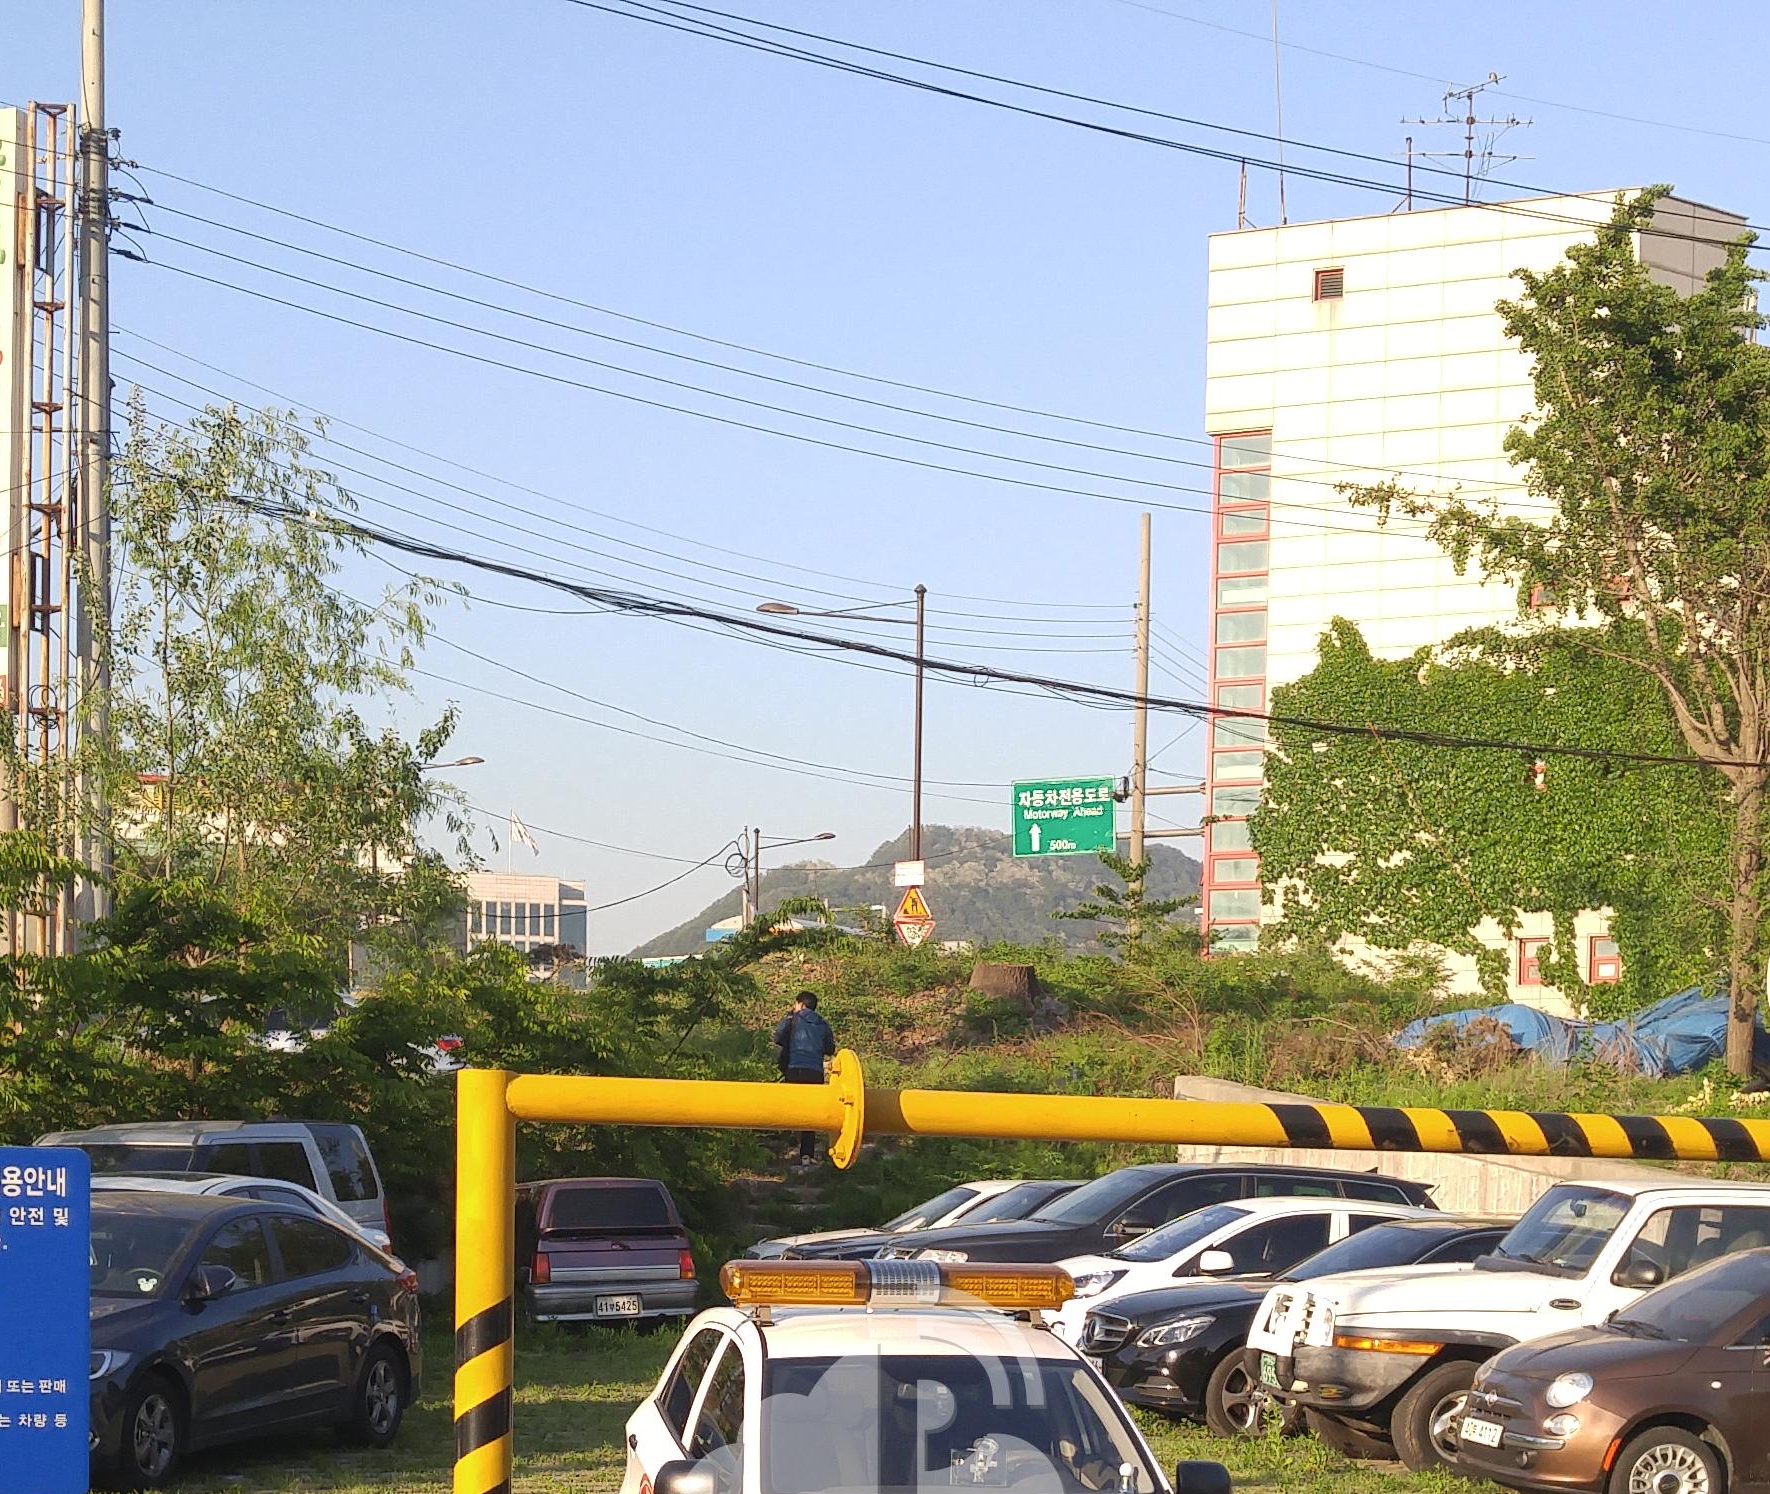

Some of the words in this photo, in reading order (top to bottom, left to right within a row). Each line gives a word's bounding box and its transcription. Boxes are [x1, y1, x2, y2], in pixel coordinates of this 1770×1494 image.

[1018, 787, 1111, 807] 자동차전용도로
[1023, 808, 1069, 820] Motorway
[1072, 804, 1104, 817] Ahead
[1049, 839, 1077, 850] 500m
[9, 1206, 44, 1226] 안전
[53, 1207, 69, 1227] 및
[6, 1379, 35, 1394] 또는
[38, 1379, 66, 1394] 판매
[17, 1413, 48, 1428] 차량
[53, 1413, 68, 1428] 등
